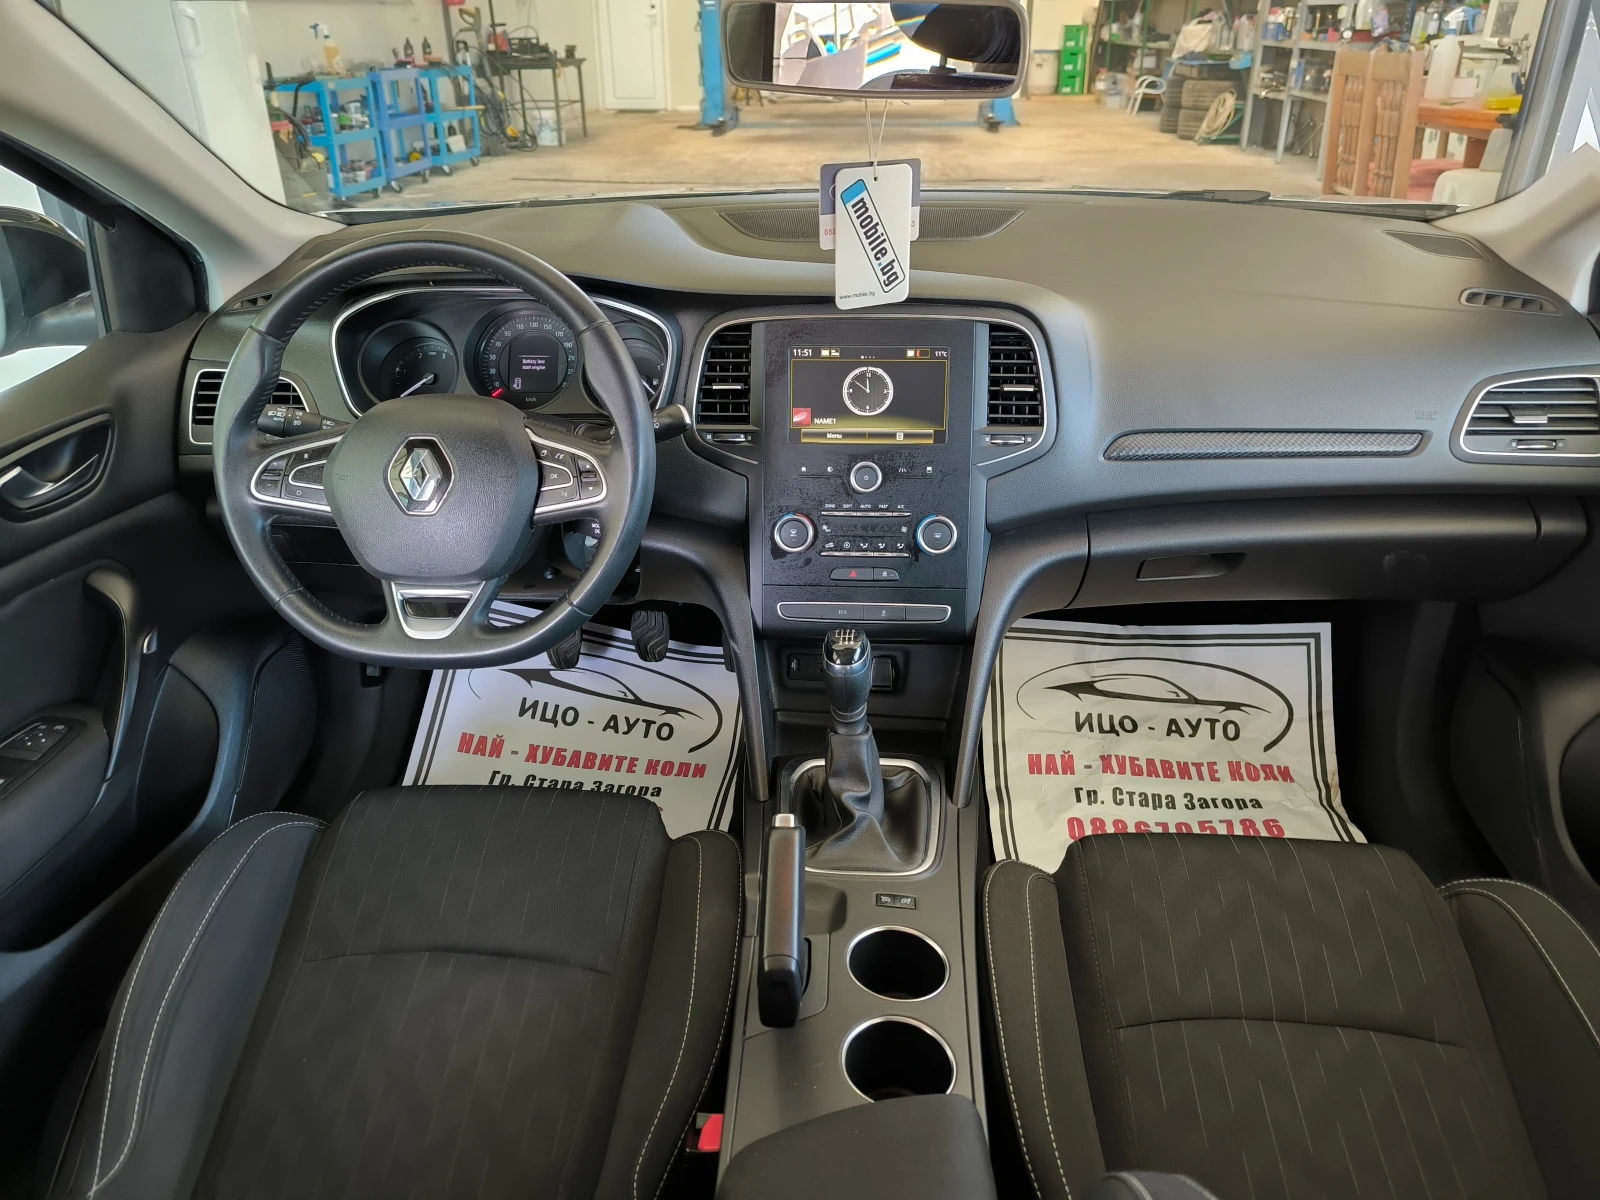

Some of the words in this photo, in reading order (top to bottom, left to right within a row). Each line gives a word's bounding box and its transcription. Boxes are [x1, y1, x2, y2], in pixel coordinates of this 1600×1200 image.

[851, 197, 899, 288] mobile.bg
[839, 291, 875, 300] www.mobile.bg
[793, 349, 812, 357] 11:51
[518, 697, 580, 728] ИЦО
[602, 714, 674, 741] АУТО
[1074, 711, 1139, 737] ИЦО
[1166, 717, 1241, 742] АУТО
[457, 732, 505, 759] НАЙ
[524, 744, 639, 774] ХУБАВИТЕ
[644, 759, 707, 778] КОЛИ
[1028, 750, 1075, 775] НАЙ
[1099, 754, 1221, 782] ХУБАВИТЕ
[1227, 760, 1296, 783] КОЛИ
[1074, 787, 1105, 806] Гр.
[1112, 787, 1176, 810] Стара
[1183, 792, 1263, 810] Загора
